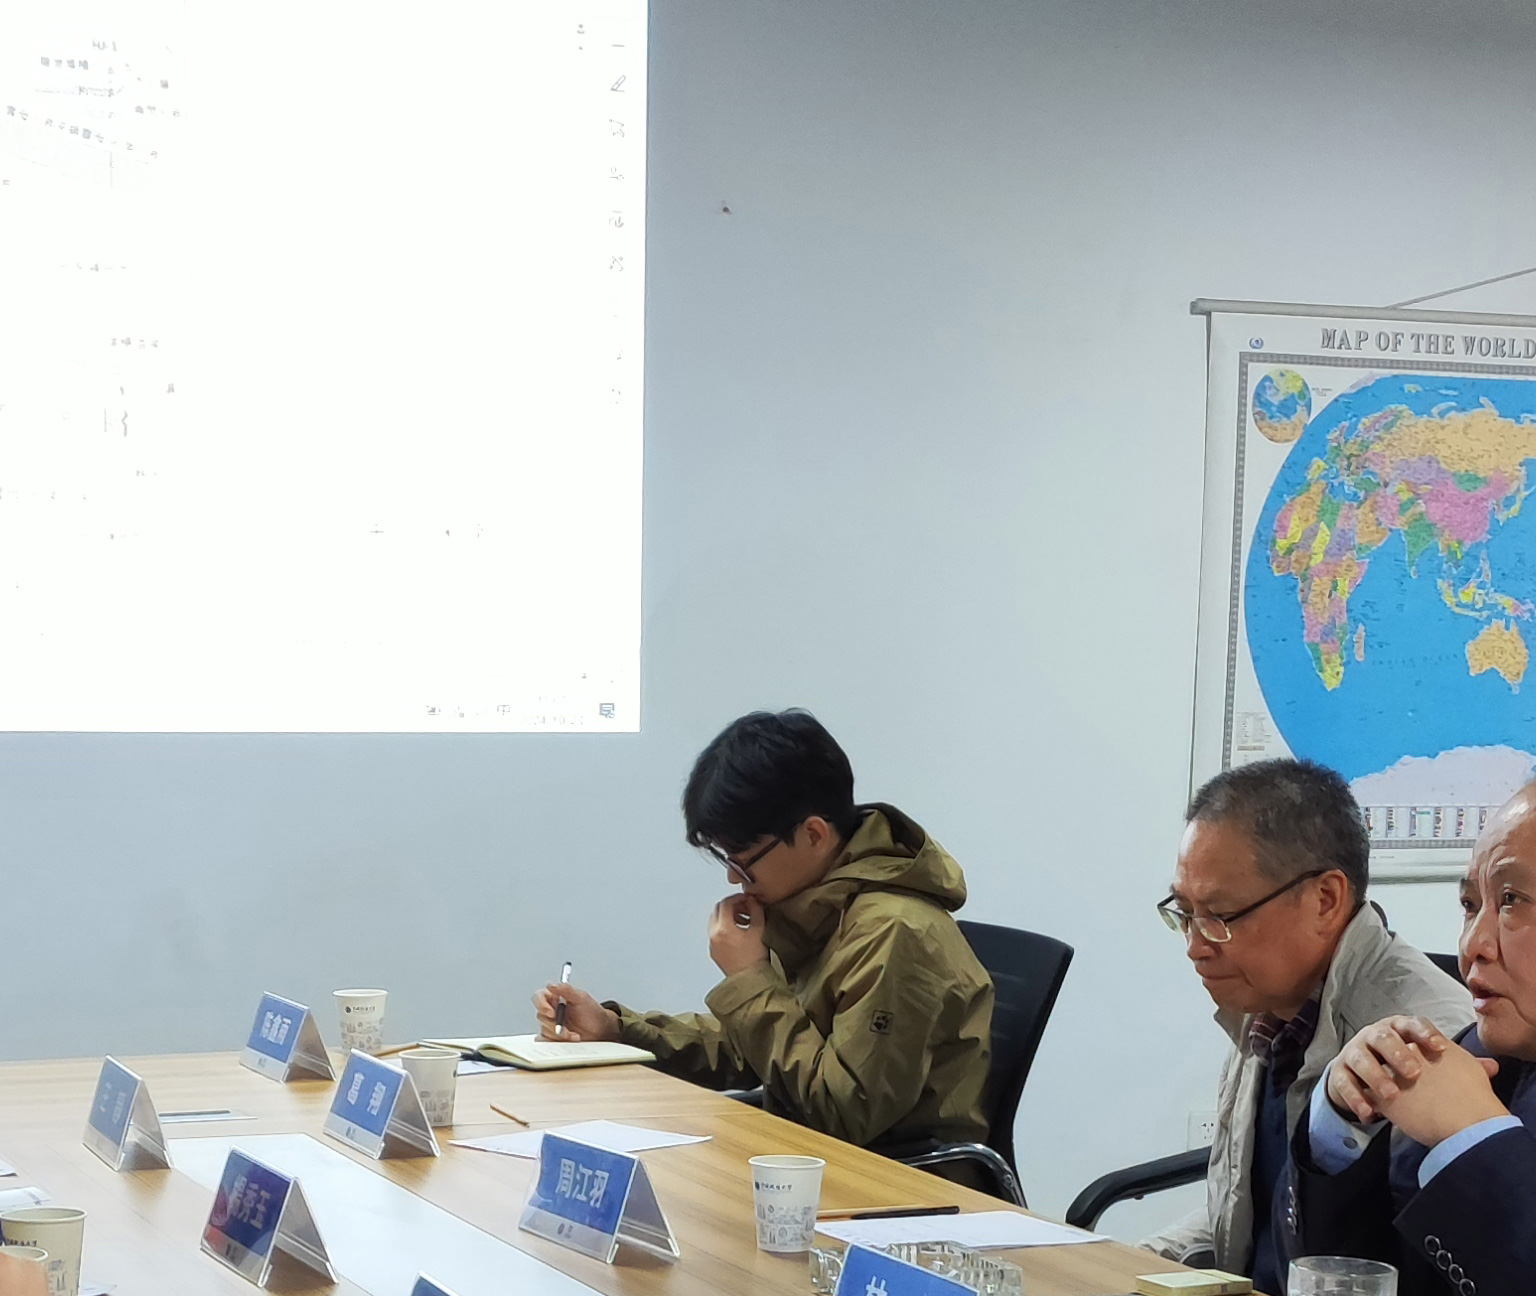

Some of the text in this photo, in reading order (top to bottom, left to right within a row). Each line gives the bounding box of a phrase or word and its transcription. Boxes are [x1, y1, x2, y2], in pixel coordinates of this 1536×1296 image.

[1320, 327, 1369, 351] MAP
[1375, 331, 1404, 353] OF
[1410, 333, 1455, 355] THE
